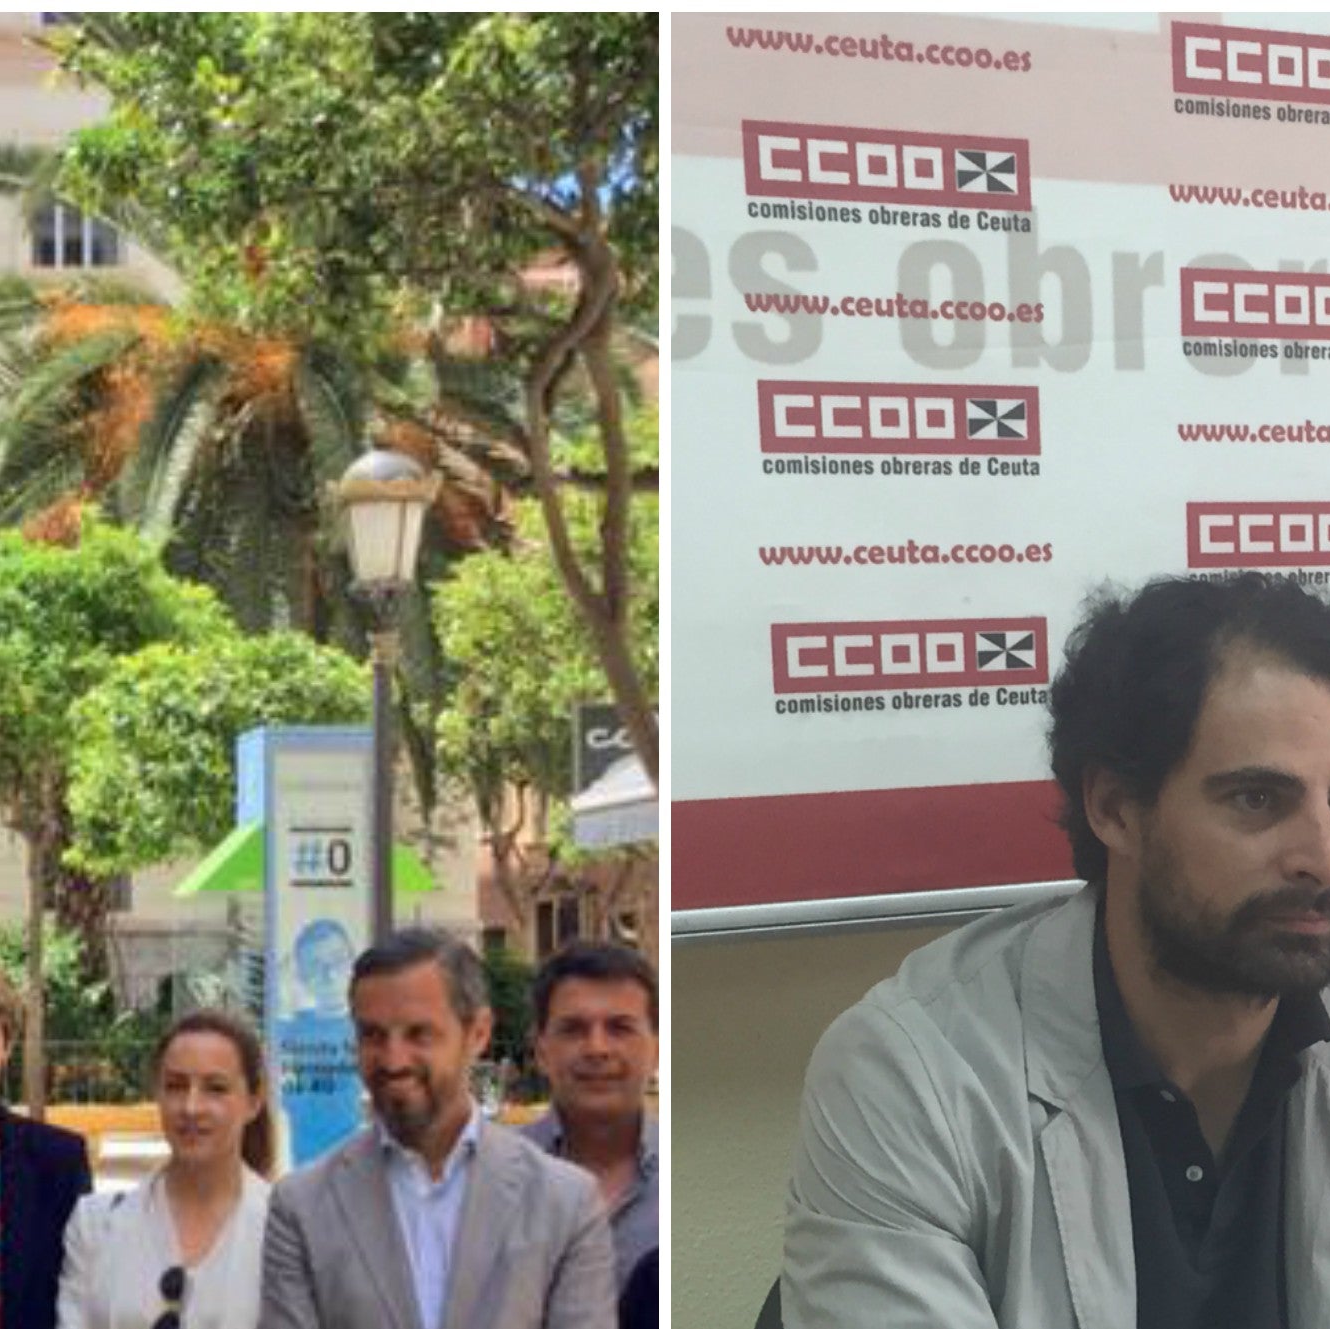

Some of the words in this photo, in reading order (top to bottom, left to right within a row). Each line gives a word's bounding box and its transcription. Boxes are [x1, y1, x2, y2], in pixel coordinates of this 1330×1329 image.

[725, 26, 1033, 72] www.ceuta.ccoo.es
[1174, 97, 1272, 121] comisiones
[758, 136, 943, 190] CCOO
[747, 201, 862, 224] comisiones
[868, 207, 944, 228] obreras
[947, 211, 970, 230] de
[977, 213, 1033, 233] Ceuta
[745, 293, 1044, 324] www.ceuta.ccoo.es
[1182, 339, 1279, 359] comisiones
[773, 395, 954, 438] CCOO
[762, 456, 875, 475] comisiones
[880, 457, 953, 476] obreras
[959, 457, 981, 476] de
[987, 458, 1040, 476] Ceuta
[759, 540, 1054, 566] www.ceuta.ccoo.es
[787, 633, 963, 677] CCOO
[774, 692, 886, 715] comisiones
[892, 690, 963, 710] obreras
[968, 688, 990, 707] de
[996, 687, 1049, 706] Ceuta
[294, 837, 352, 875] #0
